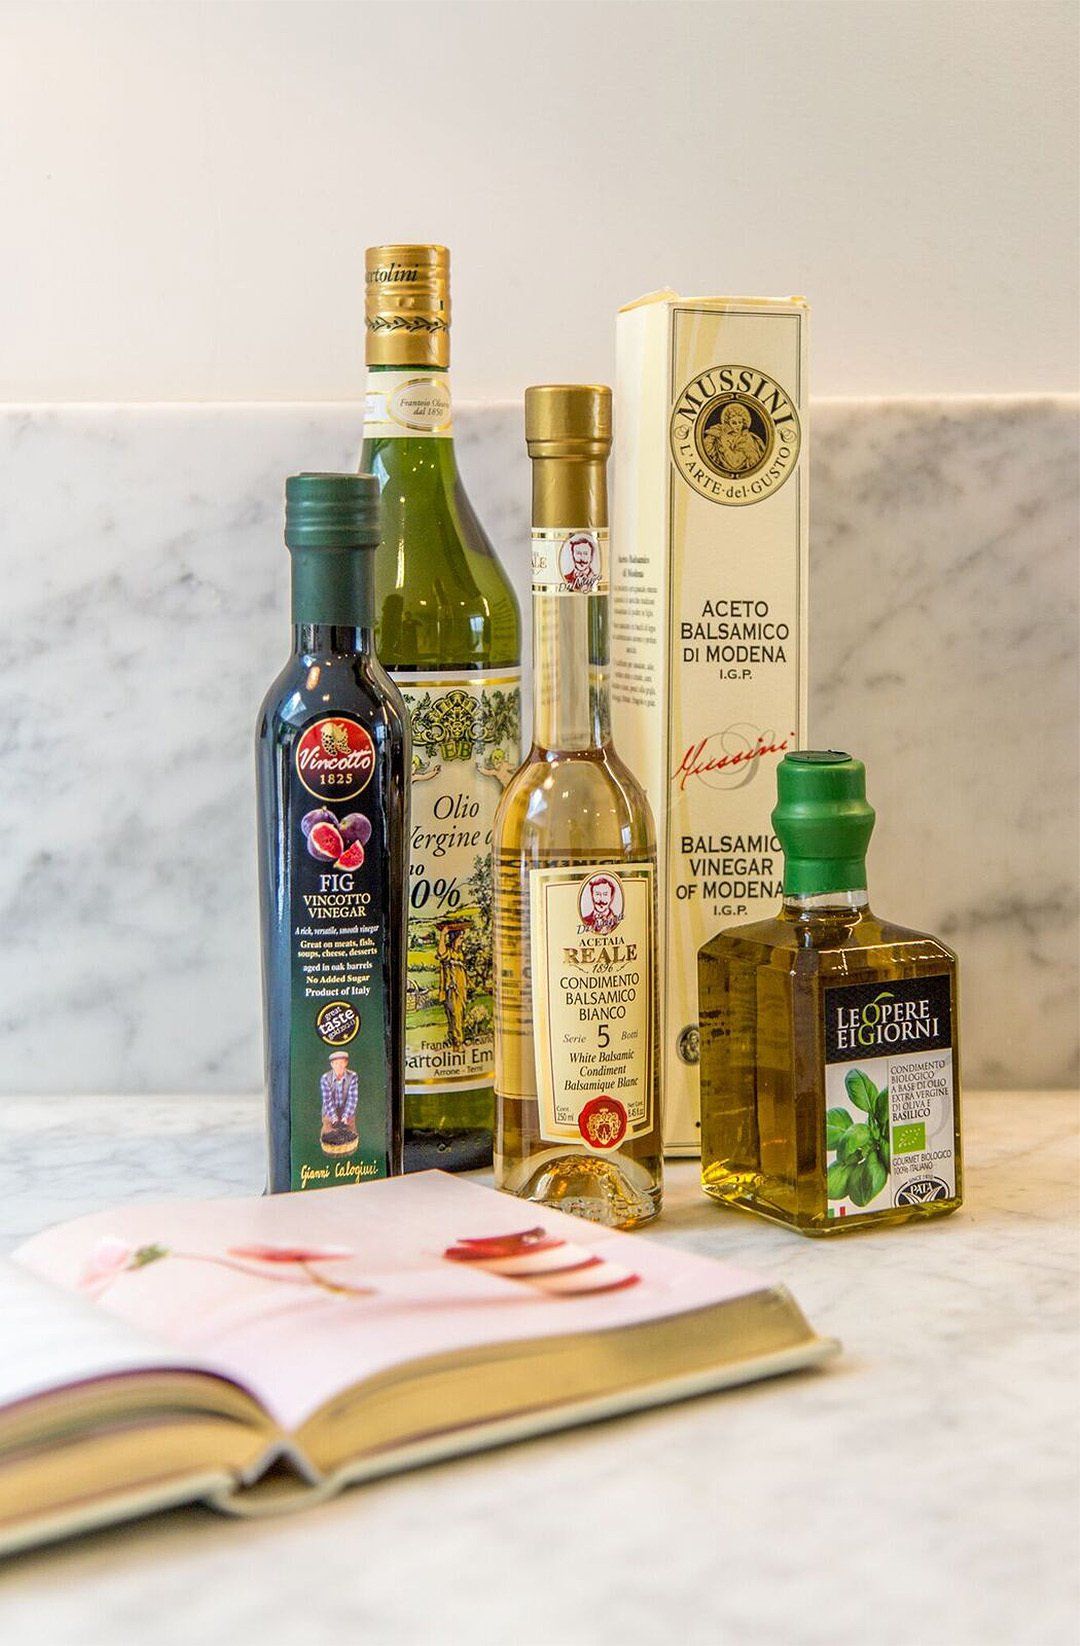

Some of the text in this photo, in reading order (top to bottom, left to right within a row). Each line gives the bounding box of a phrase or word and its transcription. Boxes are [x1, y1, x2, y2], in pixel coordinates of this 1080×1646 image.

[676, 370, 795, 425] MUSSINI
[702, 600, 769, 618] ACETO
[681, 622, 789, 640] BALSAMICO
[683, 645, 787, 663] DI MODENA
[720, 669, 753, 680] I.G.P.
[299, 746, 372, 770] Vincotto
[320, 773, 353, 785] 1825
[433, 793, 480, 820] Olio
[681, 835, 782, 854] BALSAMIC
[689, 858, 774, 876] VINEGAR
[320, 873, 355, 892] FIG
[676, 881, 784, 900] OF MODENA
[303, 892, 372, 907] VINCOTTO
[308, 906, 367, 919] VINEGAR
[713, 905, 748, 916] I.G.P.
[301, 940, 322, 949] Great
[335, 940, 358, 948] meats,
[360, 938, 375, 947] fish,
[580, 936, 625, 947] ACETAIA
[298, 948, 378, 960] soups, cheese, desserts
[563, 944, 638, 964] REALE
[303, 960, 373, 973] aged in oak barrels
[306, 973, 371, 984] No Added Sugar
[560, 972, 640, 989] CONDIMENTO
[305, 986, 371, 997] Product of Italy
[566, 988, 636, 1005] BALSAMICO
[580, 1005, 626, 1021] BIANCO
[320, 1009, 355, 1035] taste
[563, 1032, 587, 1043] Serie
[598, 1024, 610, 1048] 5
[570, 1049, 634, 1063] White Balsamic
[434, 1068, 460, 1077] Arrone
[580, 1065, 627, 1077] Condiment
[891, 1060, 945, 1075] CONDIMENTO
[564, 1076, 639, 1092] Balsamique Blanc
[891, 1070, 935, 1084] BIOLOGICO
[898, 1083, 916, 1093] BASE
[917, 1081, 926, 1090] DI
[927, 1078, 946, 1088] OLIO
[892, 1087, 950, 1103] EXTRA VERGINE
[892, 1103, 901, 1112] DI
[902, 1101, 926, 1111] OLIVA
[893, 1107, 931, 1122] BASILICO
[920, 1149, 952, 1162] BIOLOGICO
[301, 1165, 331, 1189] Gianni
